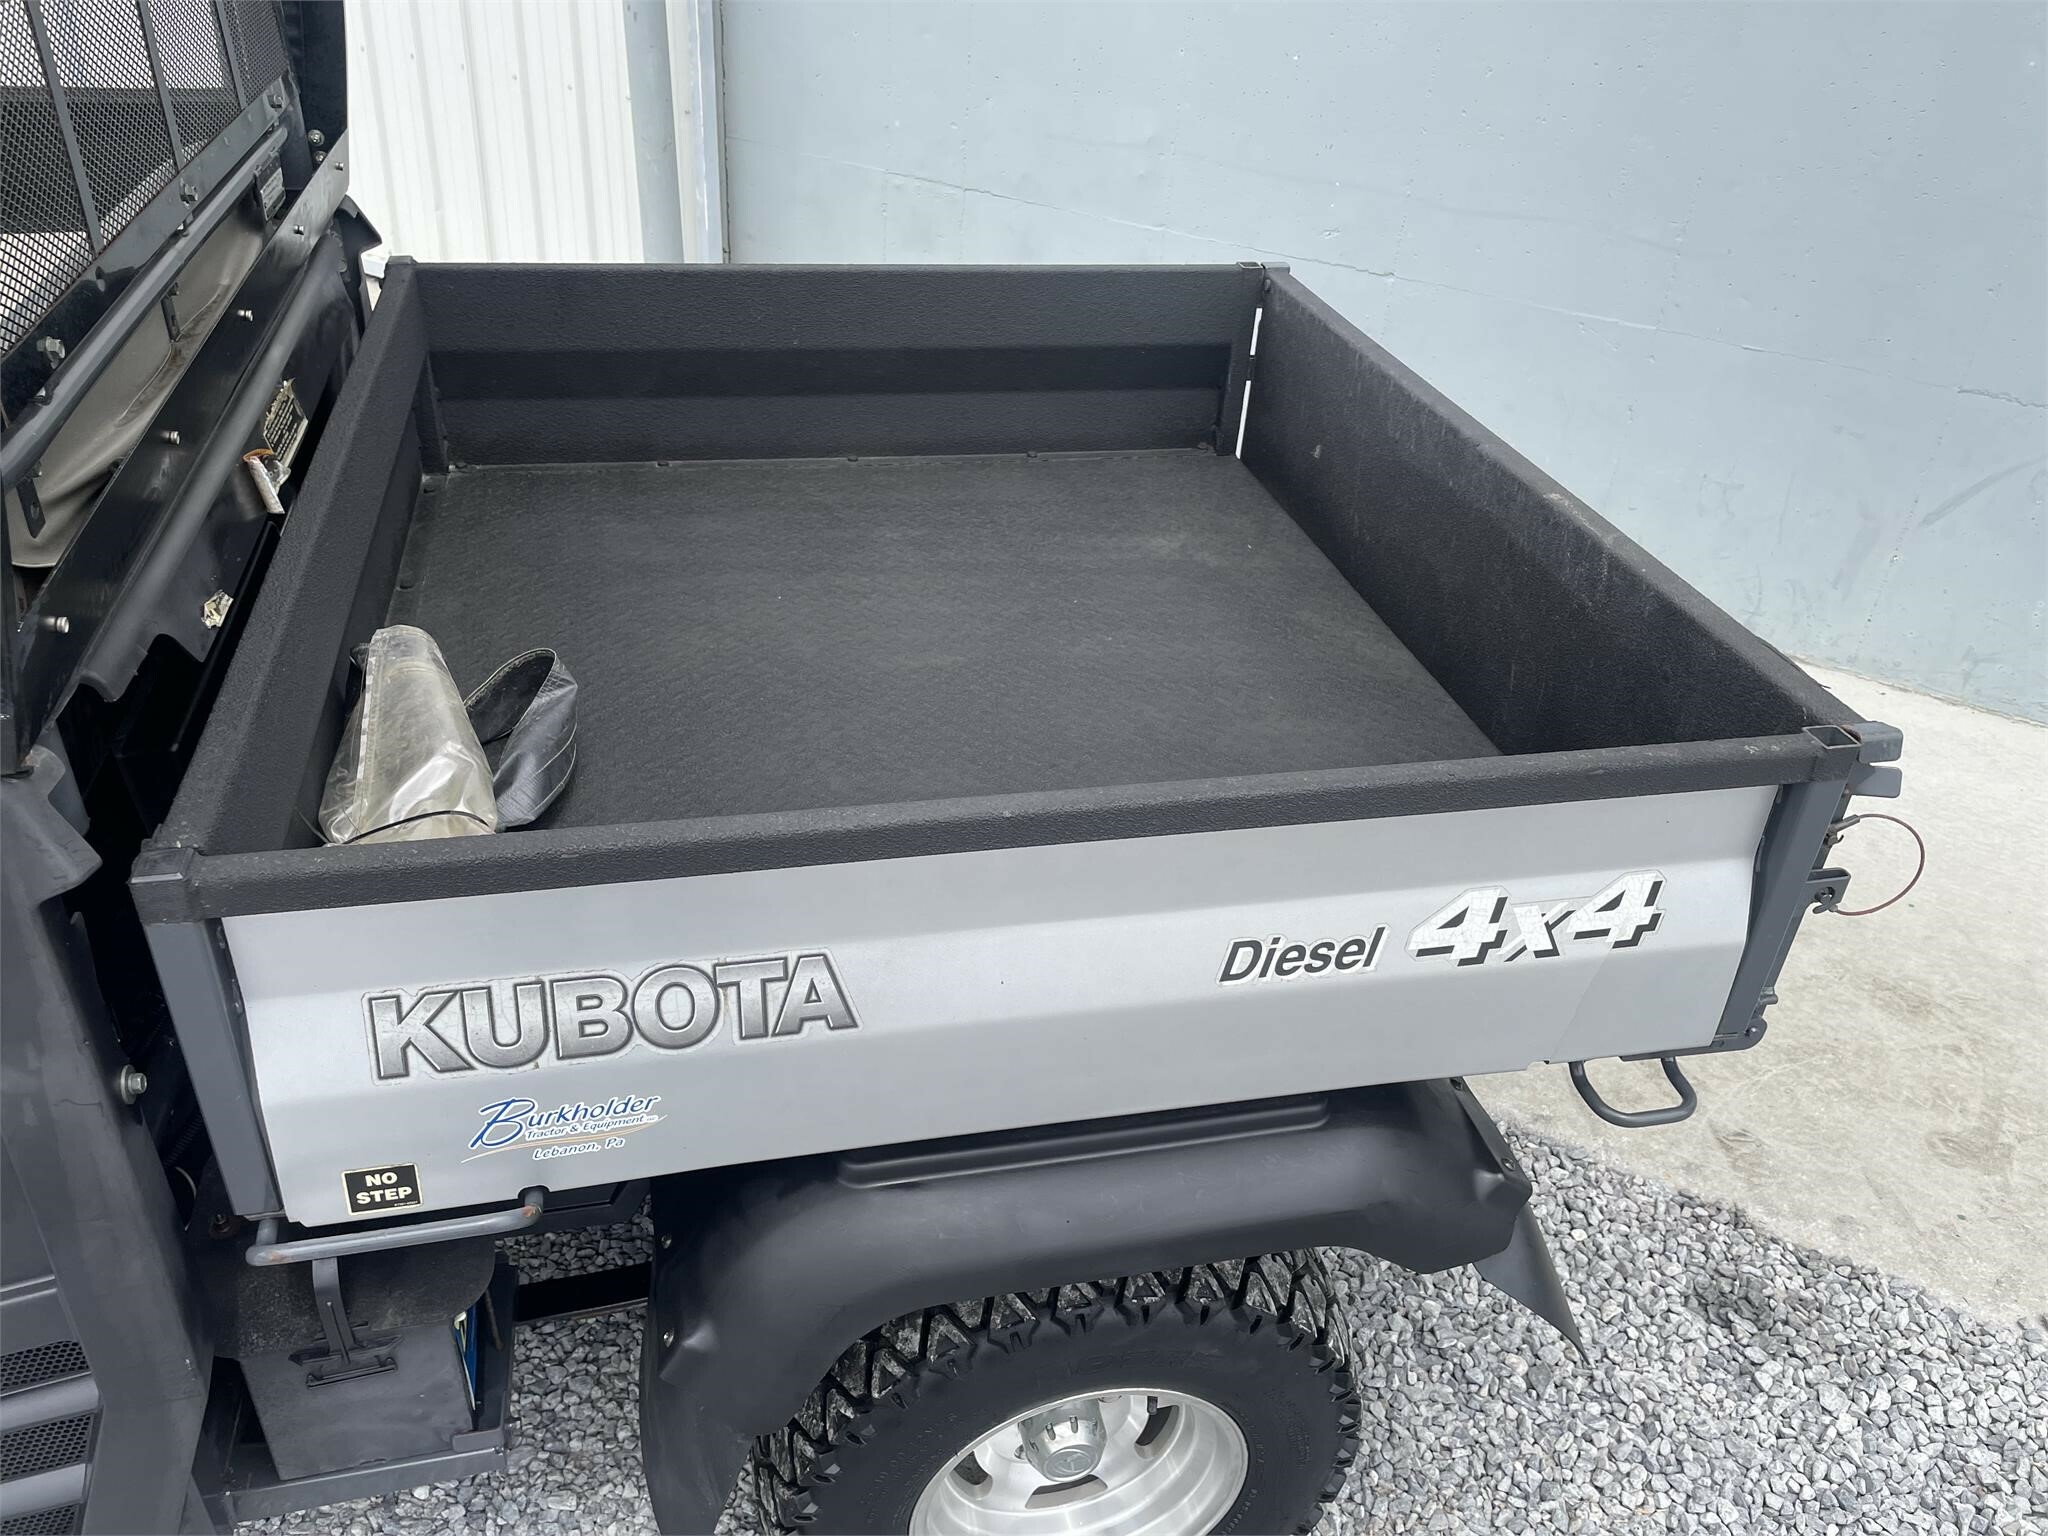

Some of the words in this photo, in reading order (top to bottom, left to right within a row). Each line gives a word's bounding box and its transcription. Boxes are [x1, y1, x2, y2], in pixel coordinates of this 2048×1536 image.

[1218, 926, 1389, 984] Diesel
[1408, 871, 1664, 967] 4x4
[366, 951, 861, 1081] KUBOTA
[470, 1095, 660, 1148] Burkholder
[526, 1127, 567, 1140] Tractor
[569, 1125, 579, 1134] &
[583, 1115, 645, 1133] Equipment
[533, 1142, 601, 1160] Lebanon,
[606, 1138, 624, 1149] Pa
[365, 1171, 398, 1187] NO
[356, 1186, 413, 1205] STEP
